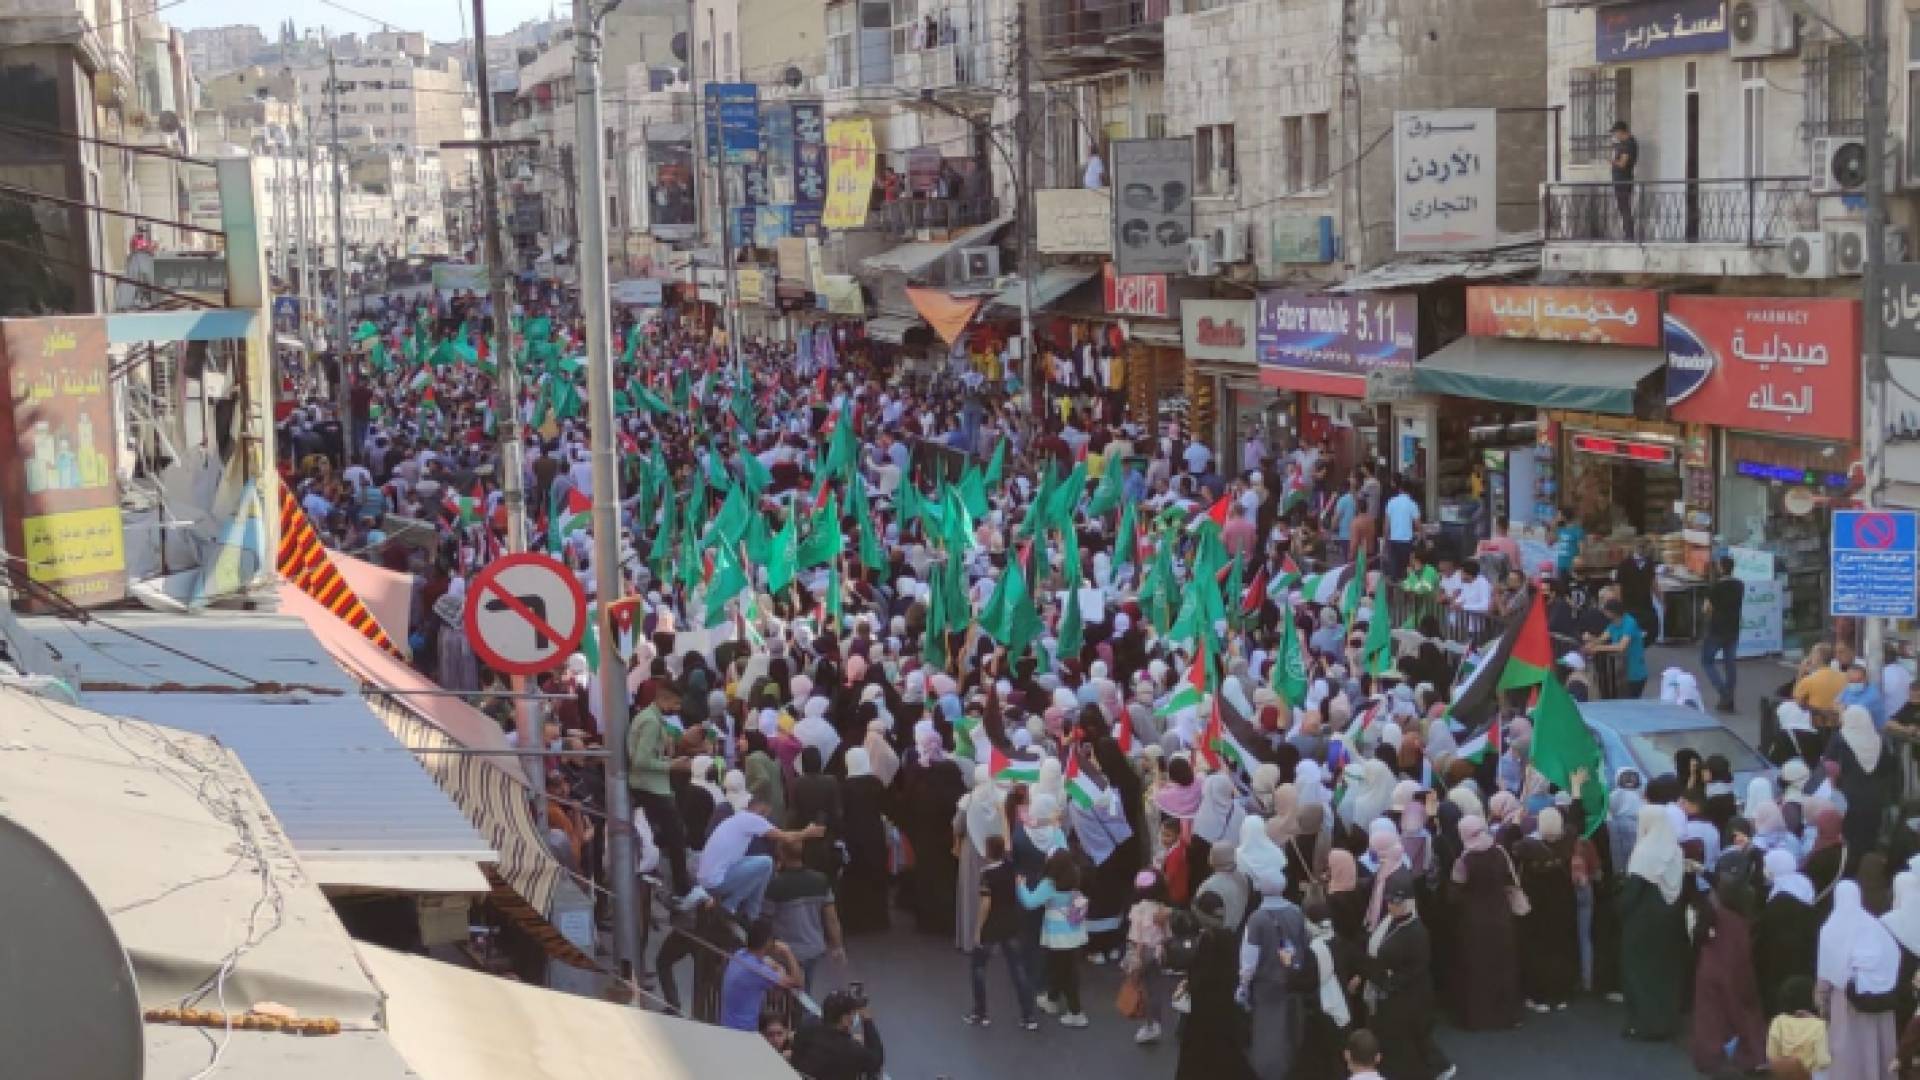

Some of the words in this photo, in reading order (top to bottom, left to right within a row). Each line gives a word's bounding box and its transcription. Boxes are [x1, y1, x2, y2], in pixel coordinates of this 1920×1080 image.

[1407, 115, 1475, 138] سوق
[1405, 146, 1479, 183] الأردن
[1408, 196, 1477, 221] التجاري
[1276, 298, 1306, 332] store
[1309, 297, 1349, 335] mobile
[1357, 298, 1395, 342] 5.11
[1745, 310, 1810, 326] PHARMACY
[1732, 327, 1829, 374] صيدلية
[1747, 383, 1813, 423] الجلاء
